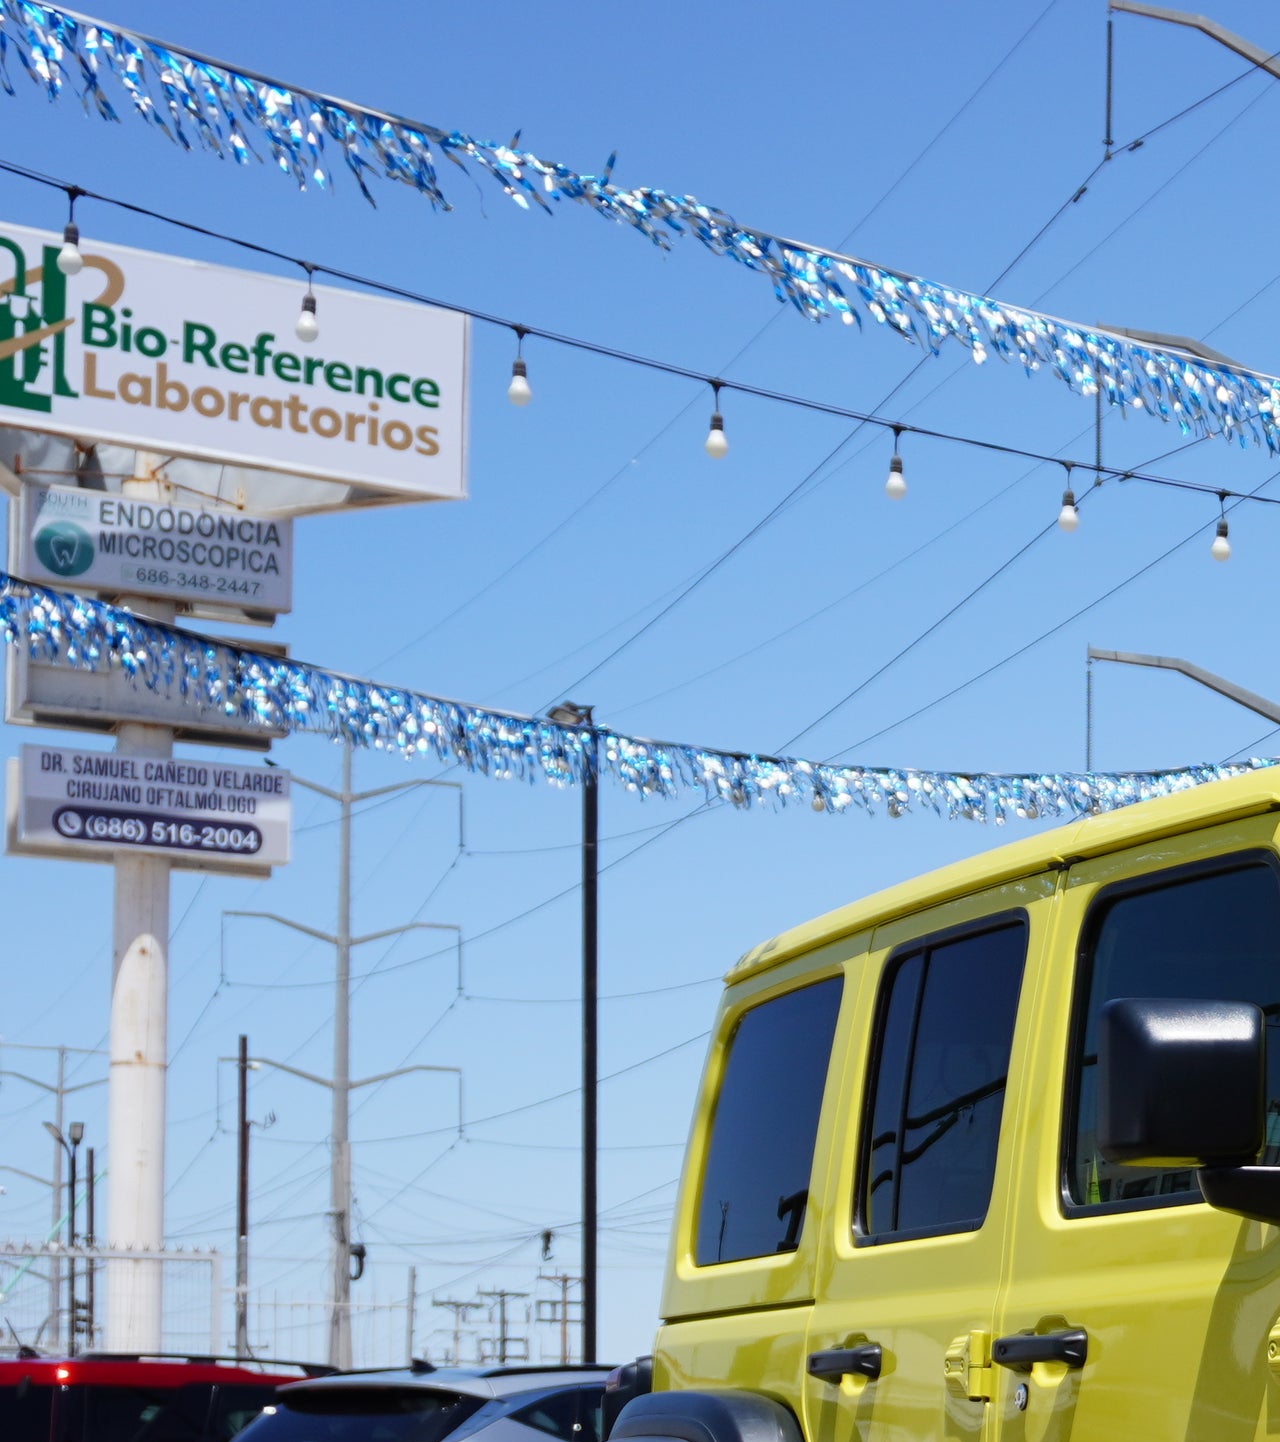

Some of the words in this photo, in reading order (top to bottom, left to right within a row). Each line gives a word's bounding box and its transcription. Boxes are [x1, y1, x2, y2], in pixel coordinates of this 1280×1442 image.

[81, 301, 441, 408] Bio-Reference
[83, 351, 441, 457] Laboratorios
[100, 500, 281, 547] ENDODONCIA
[100, 531, 280, 576] MICROSCOPICA
[136, 567, 261, 597] 686-348-2447
[40, 751, 67, 773] DR.
[73, 755, 139, 781] SAMUEL
[144, 759, 208, 787] CAÑEDO
[213, 769, 284, 795] VELARDE
[66, 779, 142, 805] CIRUJANO
[146, 787, 257, 815] OFTALMÓLOGO
[85, 814, 146, 843] (686)
[151, 821, 259, 849] 516-2004
